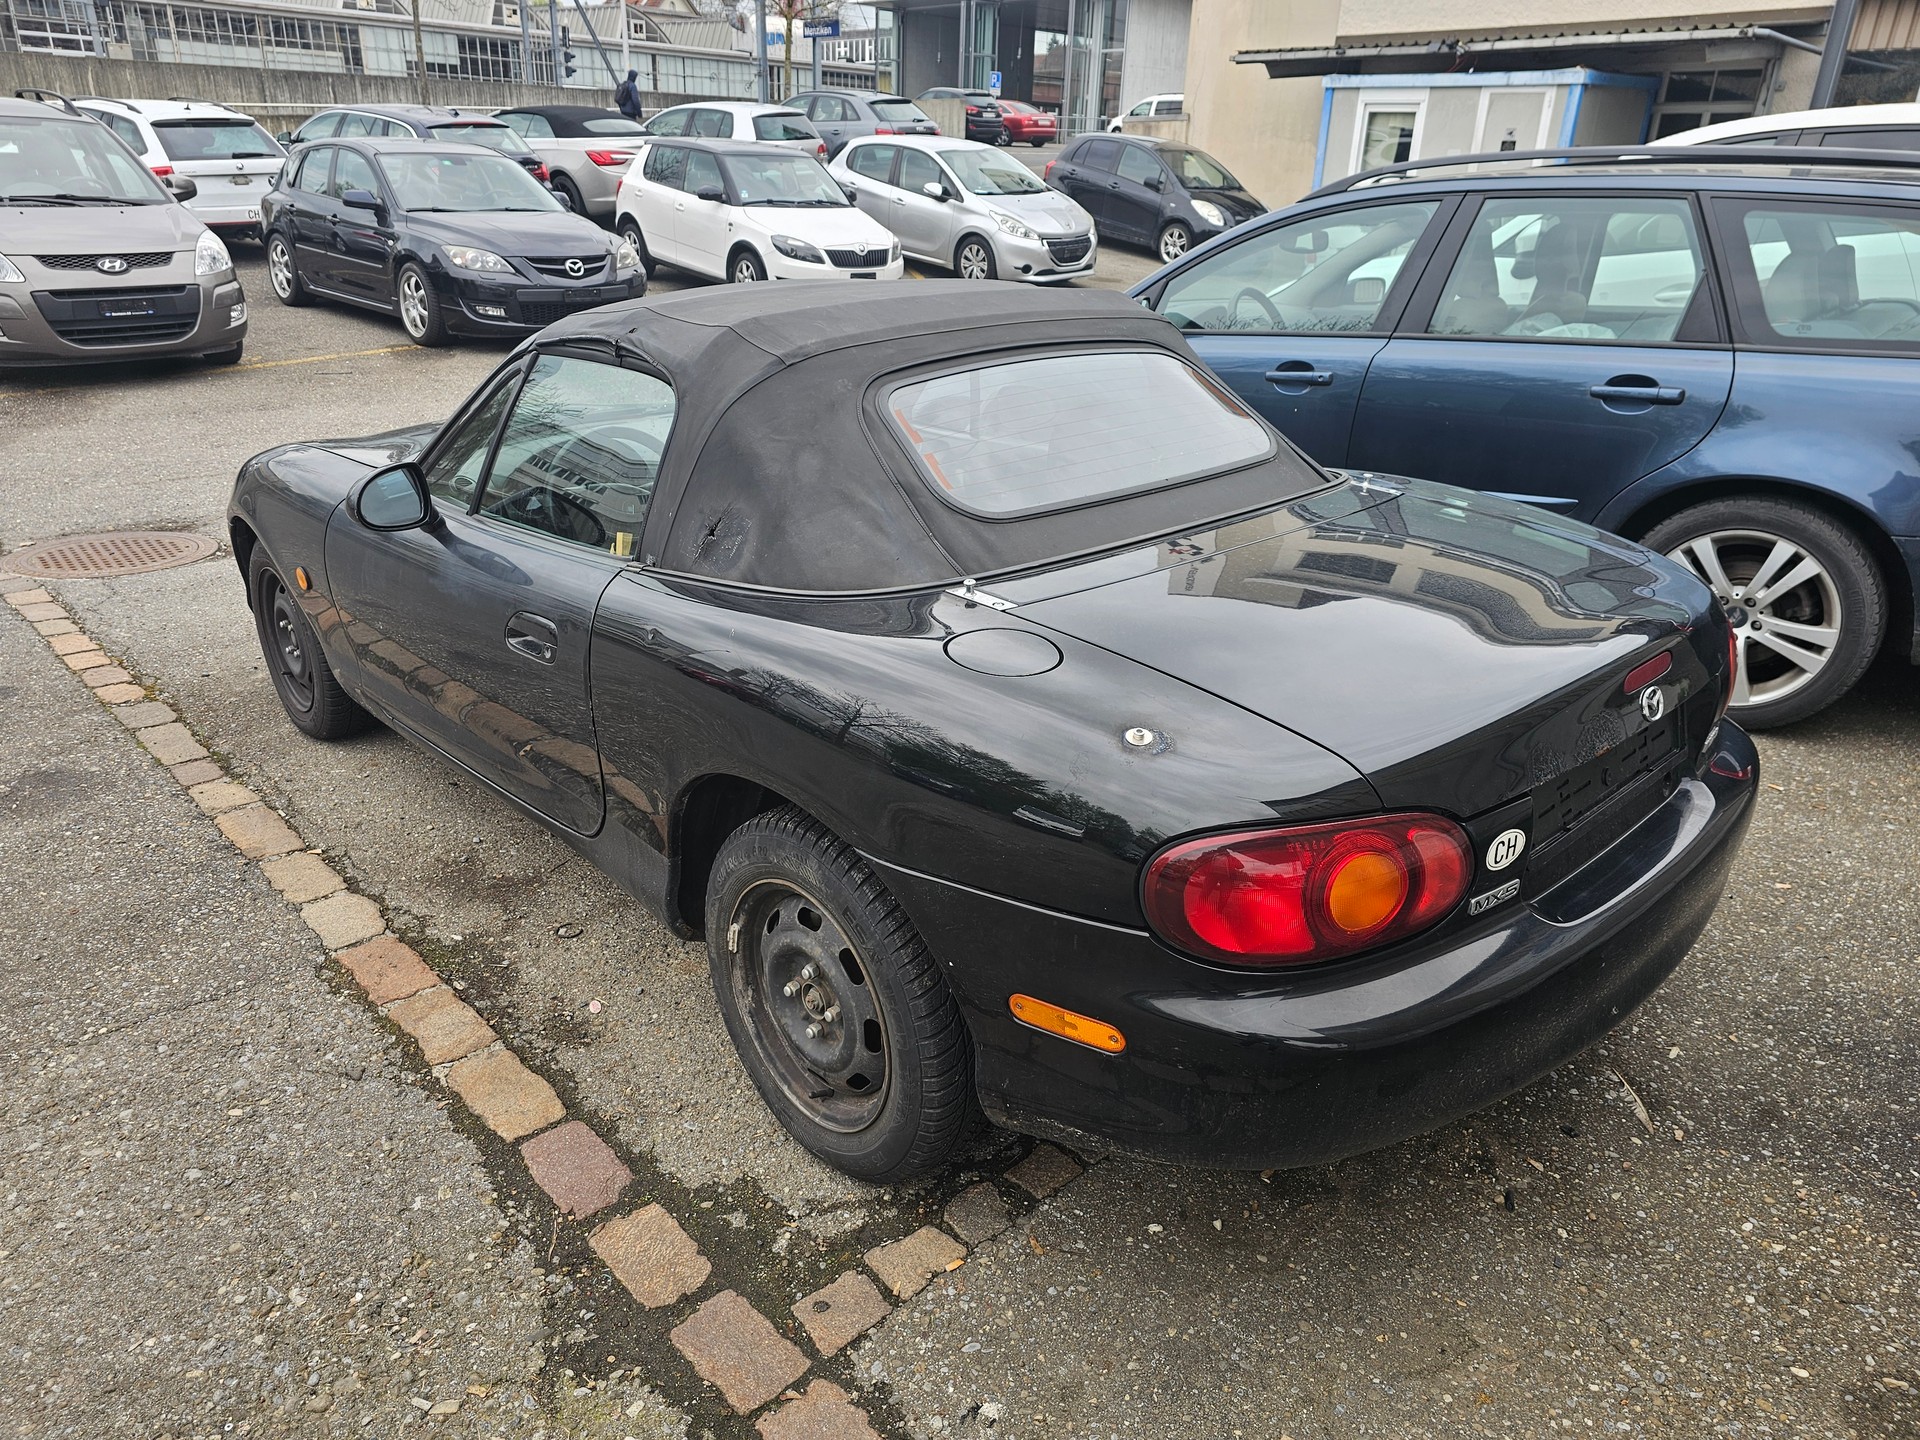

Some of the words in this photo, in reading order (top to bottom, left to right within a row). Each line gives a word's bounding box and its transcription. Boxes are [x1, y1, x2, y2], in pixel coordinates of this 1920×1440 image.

[247, 209, 261, 219] CH
[1494, 834, 1518, 865] CH
[1473, 881, 1519, 913] MX-5
